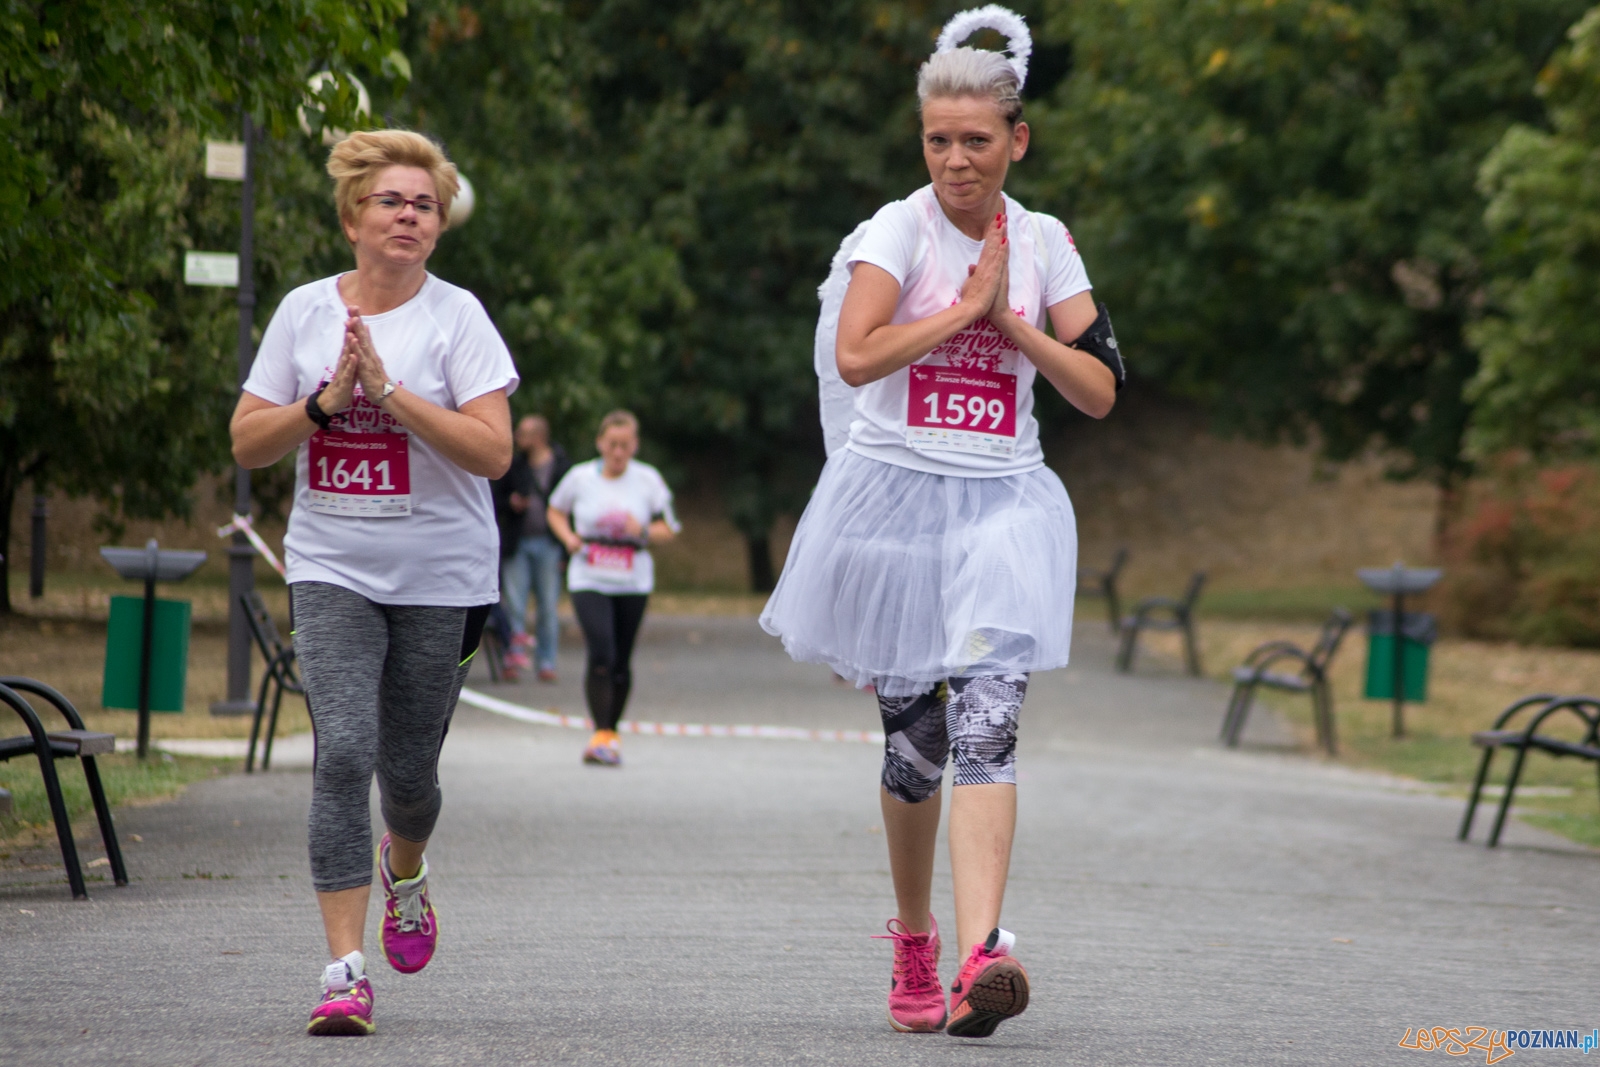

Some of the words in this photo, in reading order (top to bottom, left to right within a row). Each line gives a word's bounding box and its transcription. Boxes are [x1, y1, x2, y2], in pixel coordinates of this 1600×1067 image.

[935, 375, 960, 383] Zawsze
[985, 380, 1001, 389] 2016
[923, 392, 1005, 429] 1599
[369, 442, 388, 450] 2016
[316, 456, 396, 490] 1641
